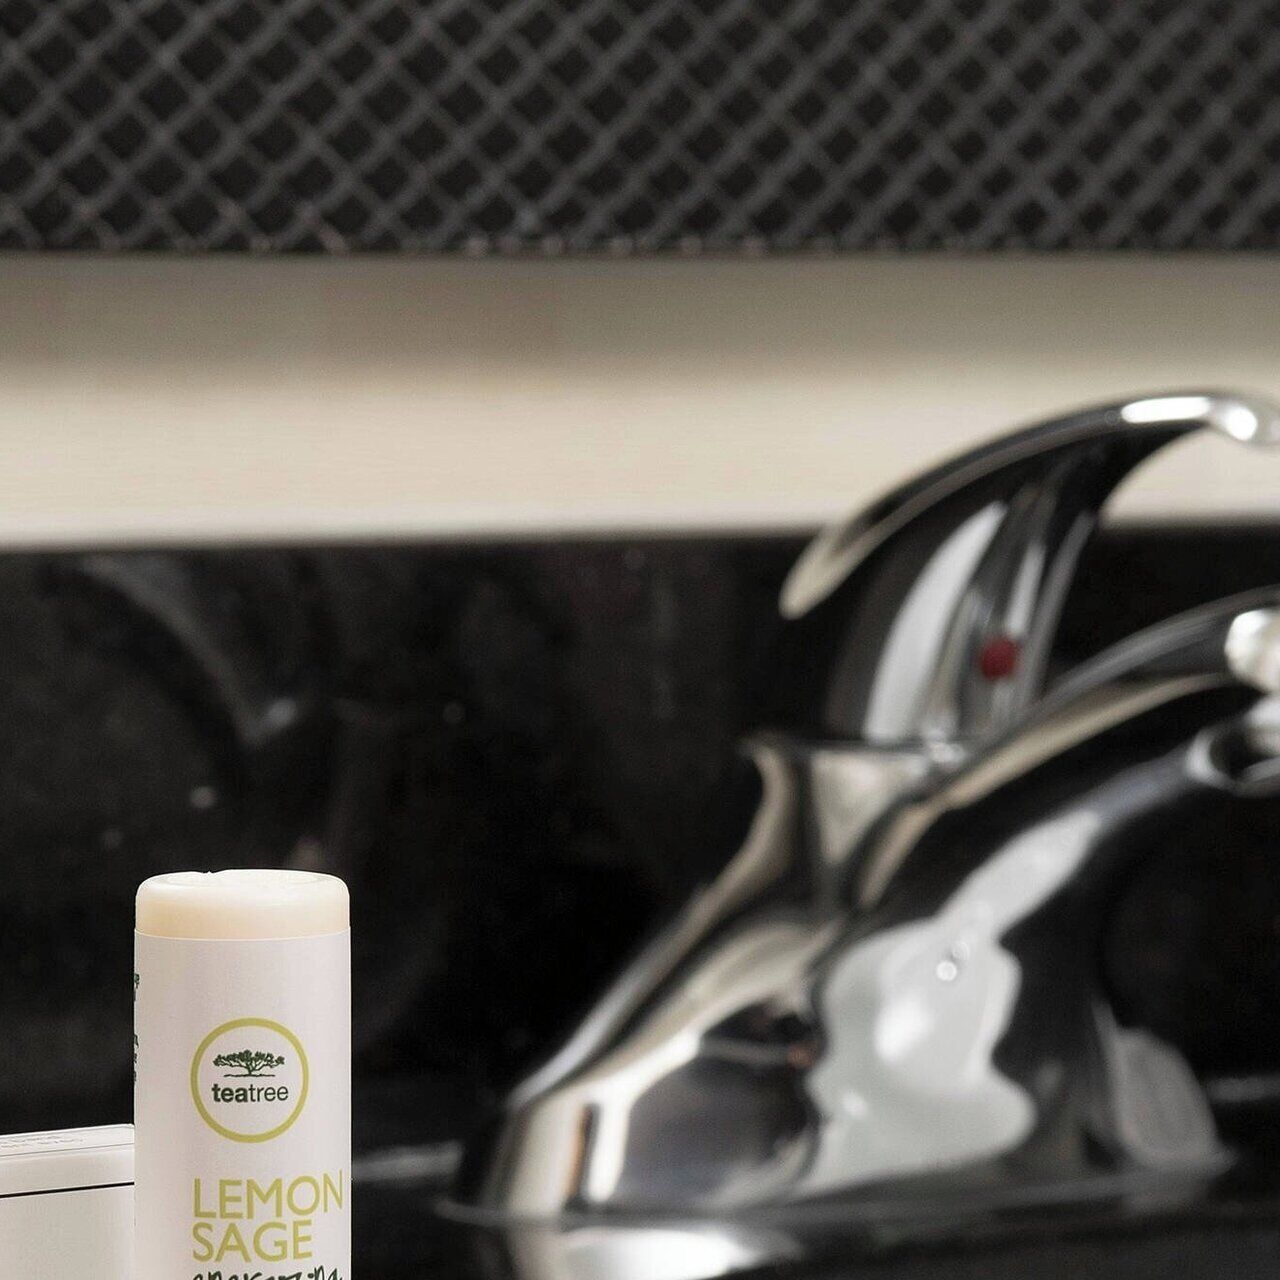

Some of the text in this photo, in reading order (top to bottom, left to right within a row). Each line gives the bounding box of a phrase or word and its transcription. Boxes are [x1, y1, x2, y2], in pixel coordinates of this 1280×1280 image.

[211, 1083, 289, 1103] teatree
[193, 1169, 343, 1219] LEMON
[192, 1220, 313, 1263] SAGE
